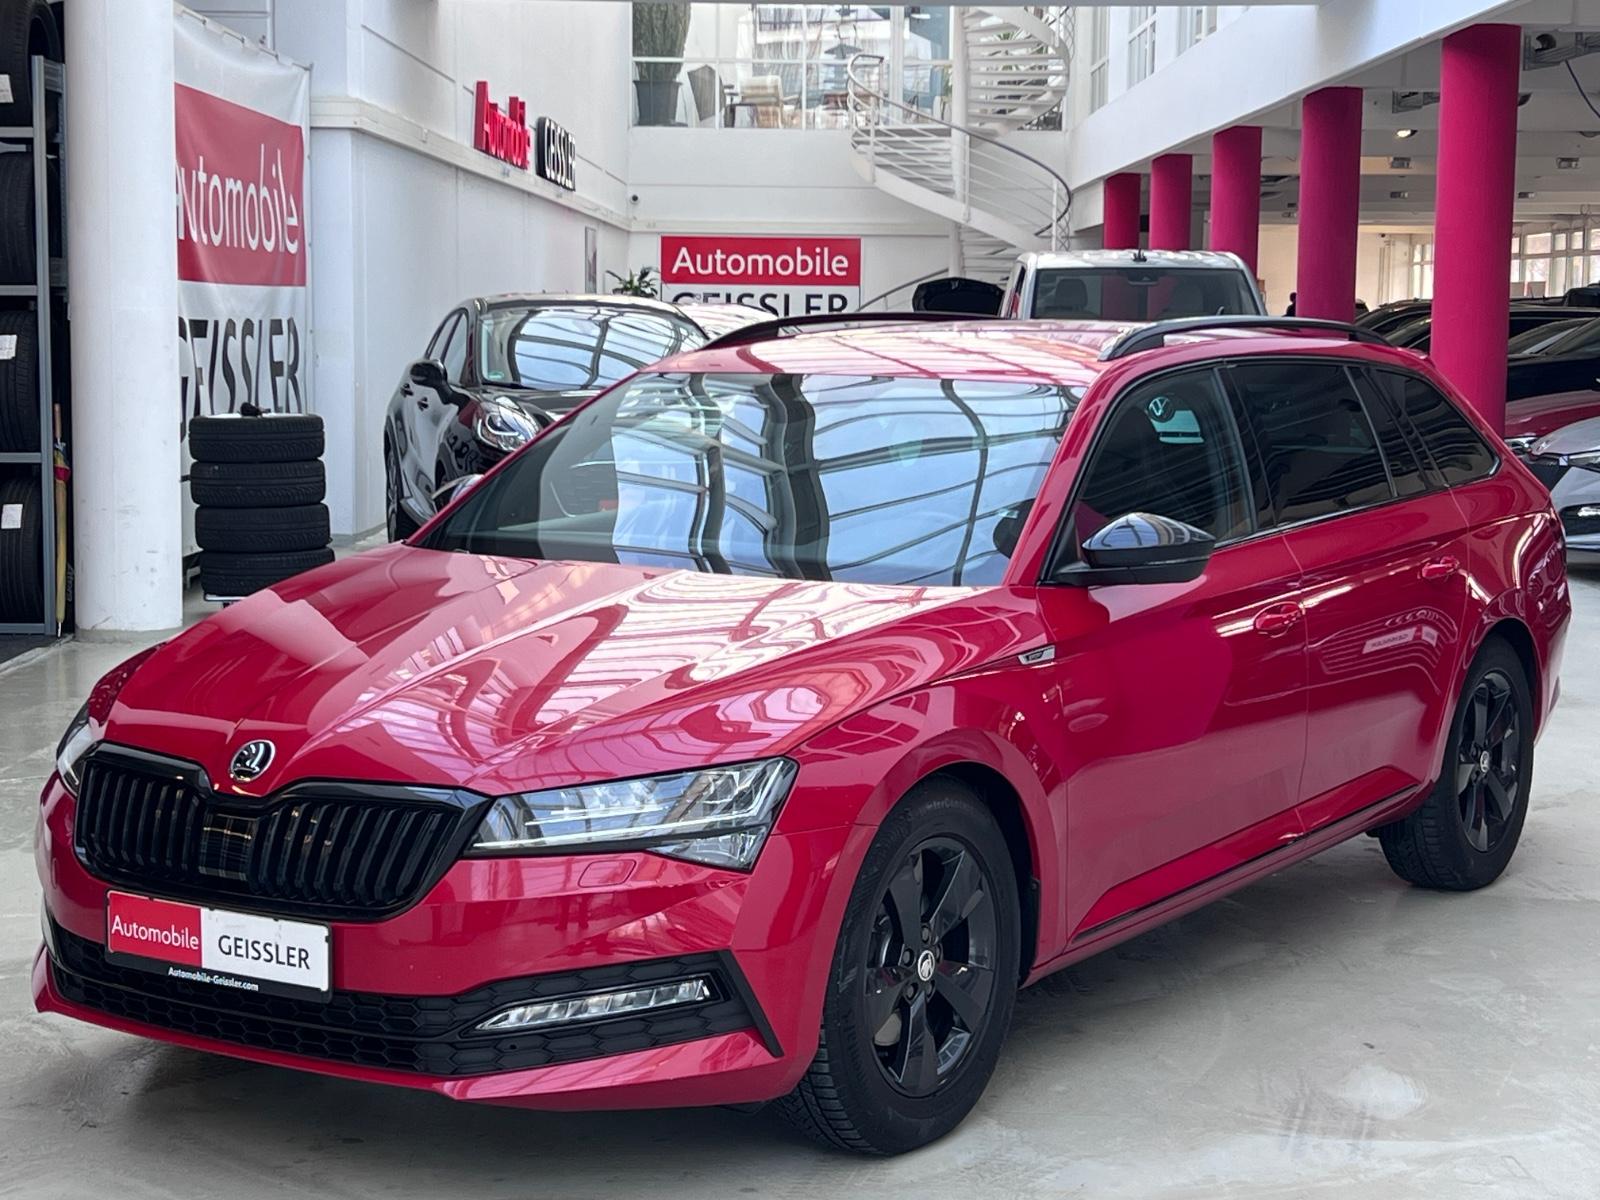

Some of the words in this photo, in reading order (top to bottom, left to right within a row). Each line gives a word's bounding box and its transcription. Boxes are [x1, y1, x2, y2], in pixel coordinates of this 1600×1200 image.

[672, 247, 849, 276] Automobile
[111, 914, 199, 950] Automobile
[218, 935, 311, 970] GEISSLER
[168, 966, 259, 992] Automobile-Geissler.com
